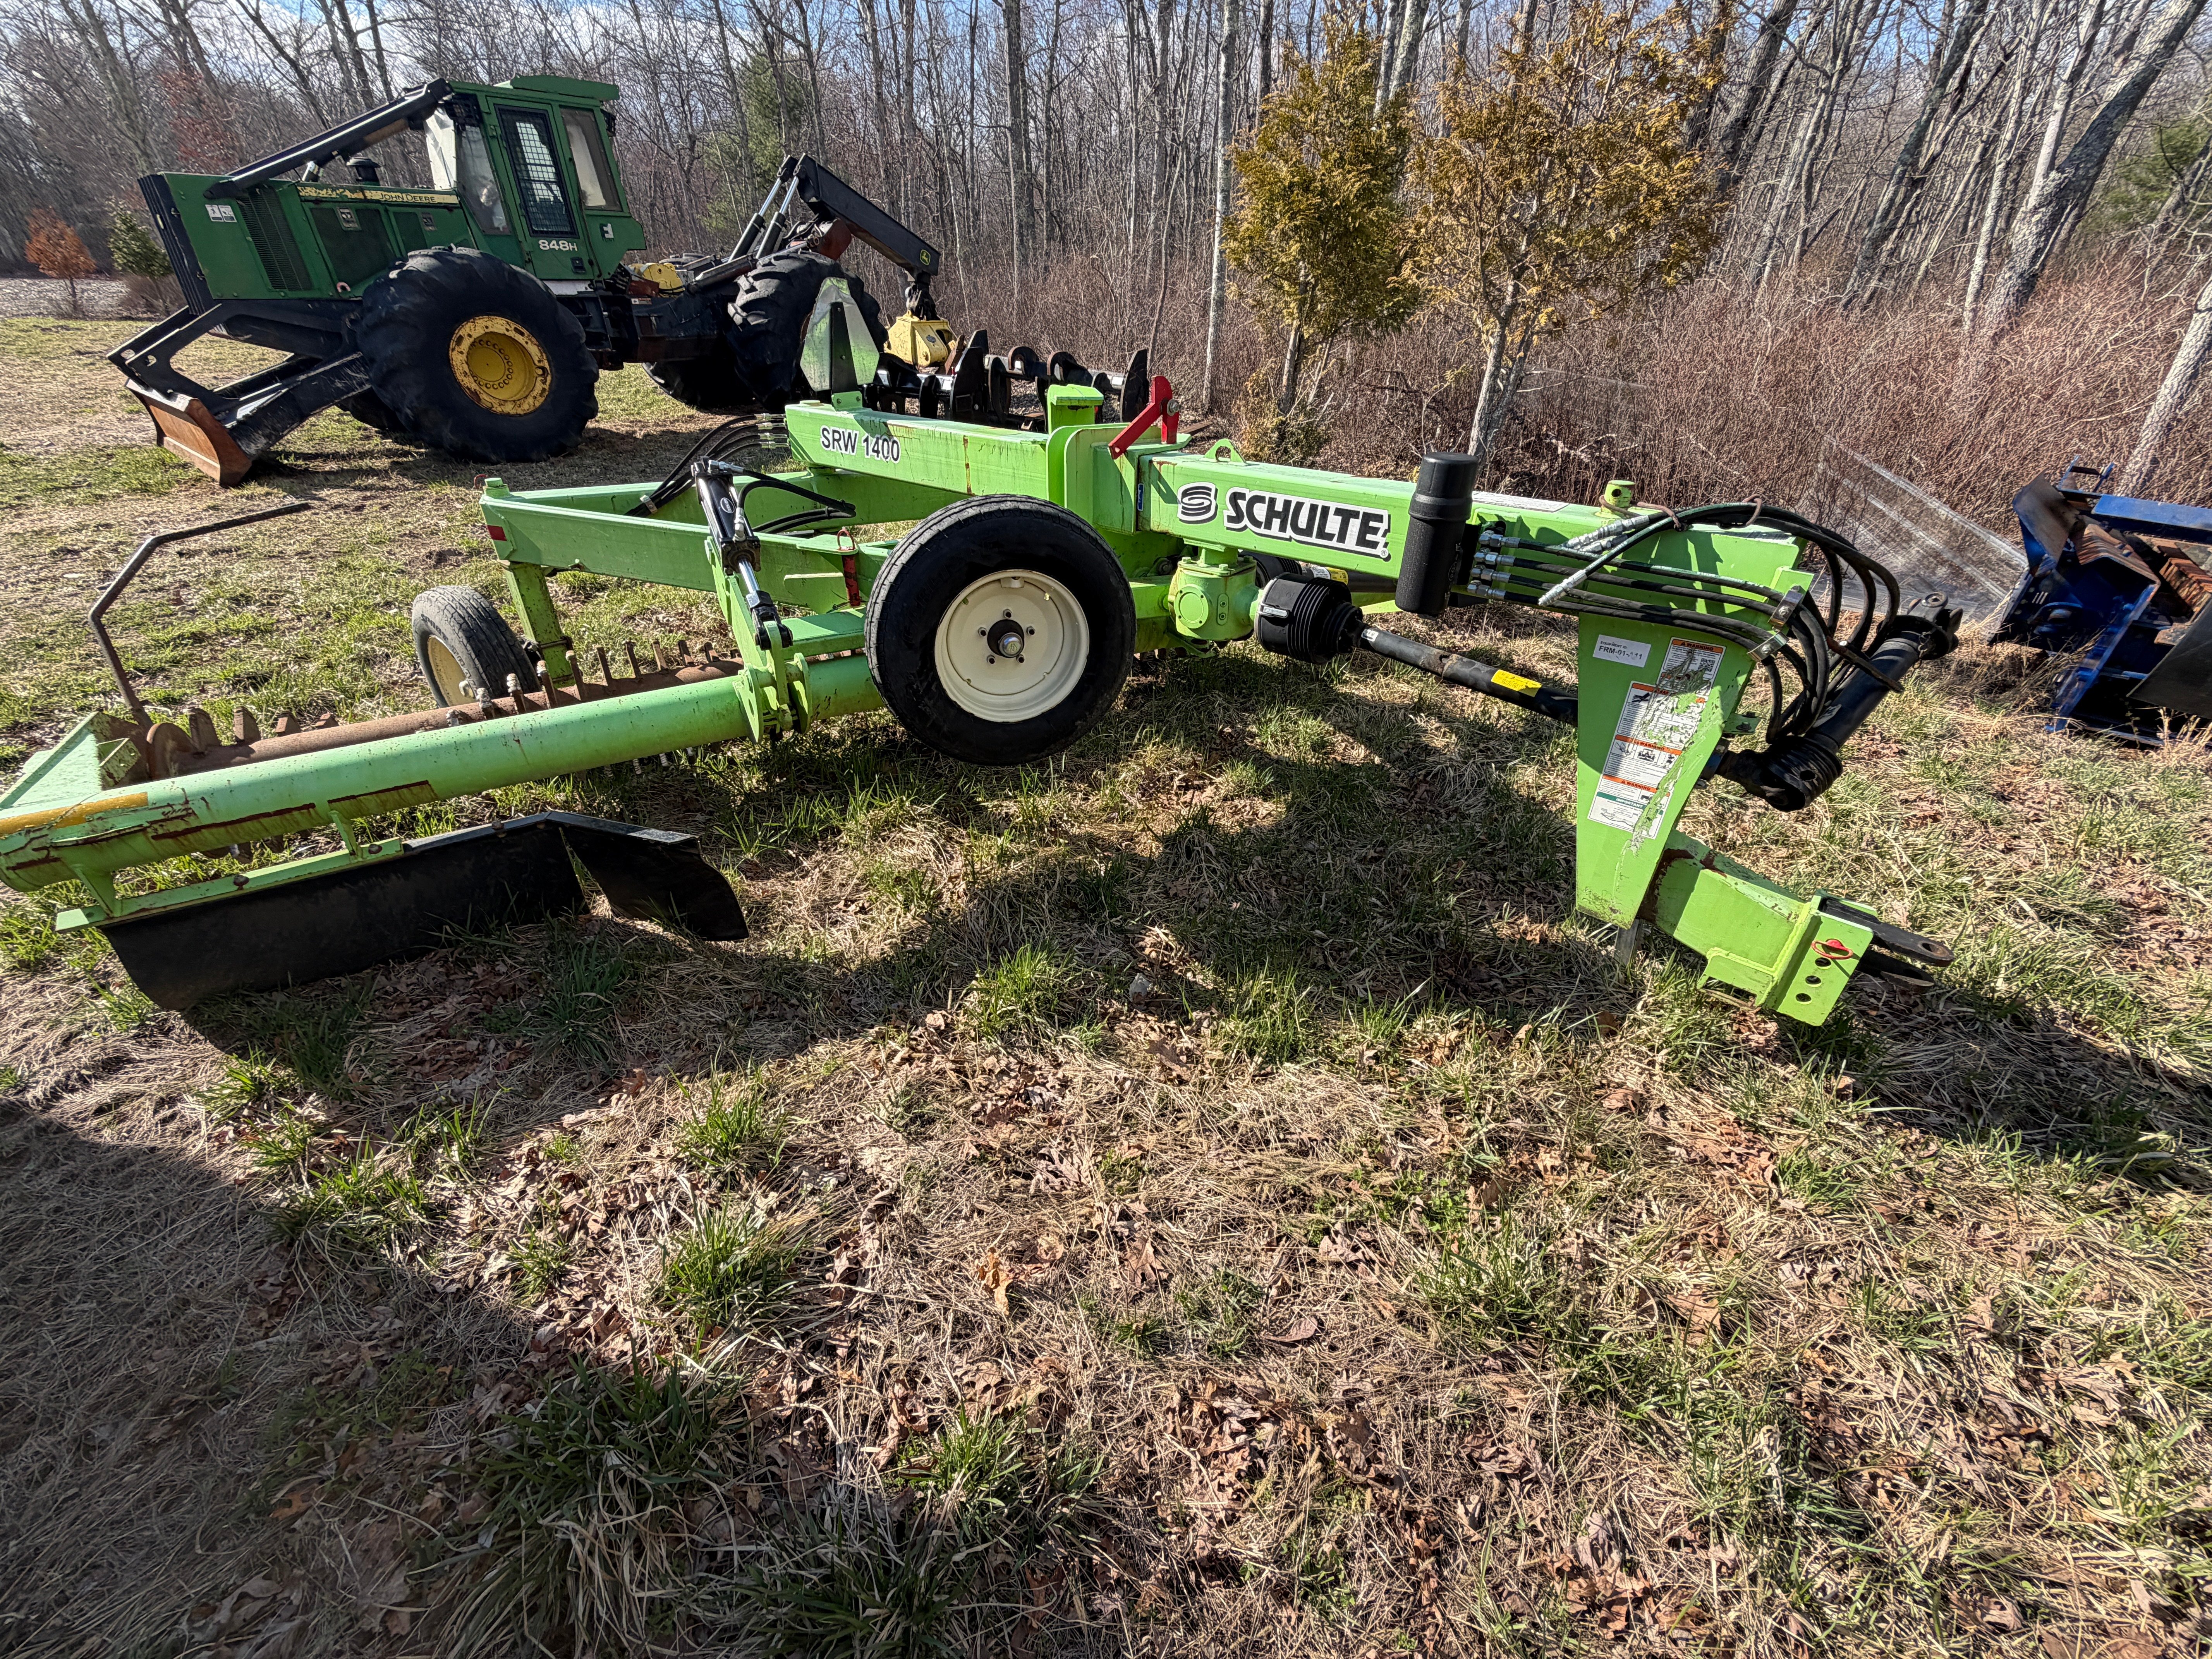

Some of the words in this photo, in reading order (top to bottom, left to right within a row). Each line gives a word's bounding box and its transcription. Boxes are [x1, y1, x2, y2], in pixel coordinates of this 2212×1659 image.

[405, 193, 436, 203] DEERE
[538, 239, 578, 251] 848H
[821, 427, 858, 454] SRW
[862, 435, 900, 462] 1400
[1226, 491, 1385, 550] SCHULTE
[1687, 643, 1714, 651] WARNING
[1640, 742, 1665, 751] WARNING
[1627, 781, 1651, 791] WARNING
[1616, 798, 1644, 808] IMPORTANT
